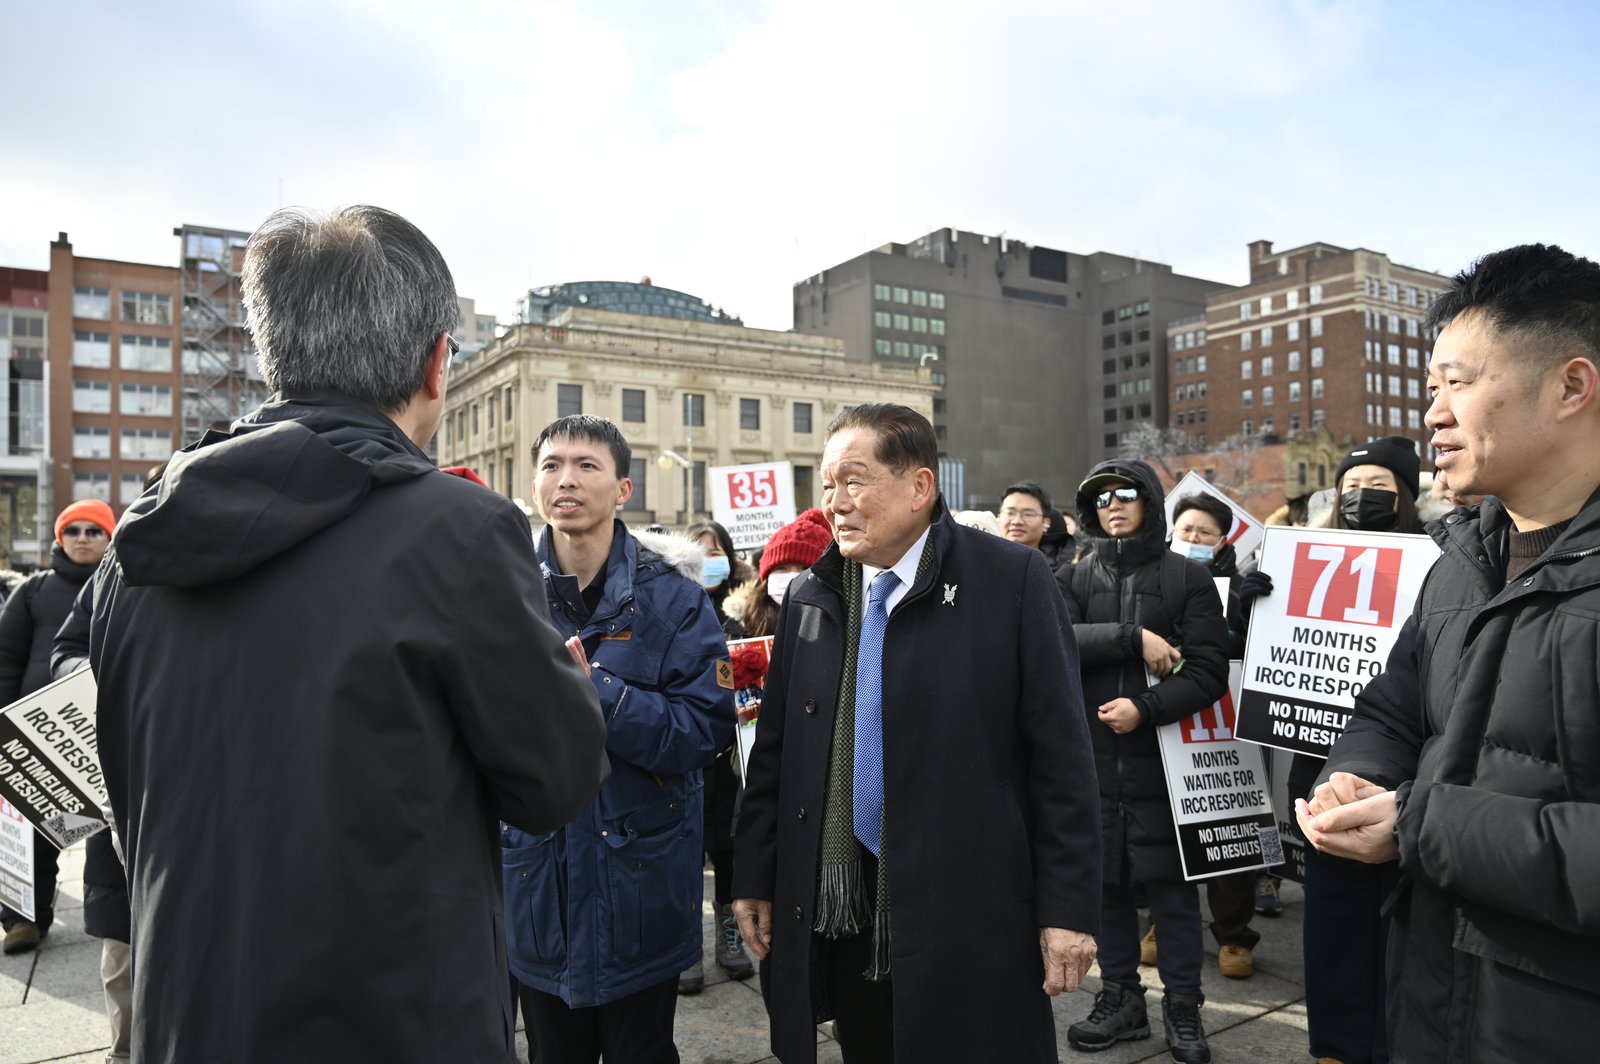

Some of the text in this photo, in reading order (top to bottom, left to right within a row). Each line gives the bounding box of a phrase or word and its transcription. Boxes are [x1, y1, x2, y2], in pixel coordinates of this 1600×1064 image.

[733, 471, 773, 508] 35
[727, 522, 765, 533] WAITING
[736, 511, 774, 521] MONTHS
[1307, 545, 1380, 624] 71
[1292, 626, 1377, 654] MONTHS
[1270, 646, 1382, 678] WAITING FO
[1255, 666, 1363, 698] IRCC RESPO
[1268, 700, 1352, 730] NO TIMELI
[1272, 721, 1295, 738] NO
[23, 706, 103, 794] IRCC RESPO
[1192, 750, 1239, 769] MONTHS
[2, 739, 30, 760] NO
[21, 755, 85, 815] TIMELINES
[1183, 770, 1255, 792] WAITING FOR
[4, 771, 63, 821] RESULTS
[1180, 790, 1265, 815] IRCC RESPONSE
[1198, 822, 1260, 844] NO TIMELINES
[1206, 840, 1261, 862] NO RESULTS
